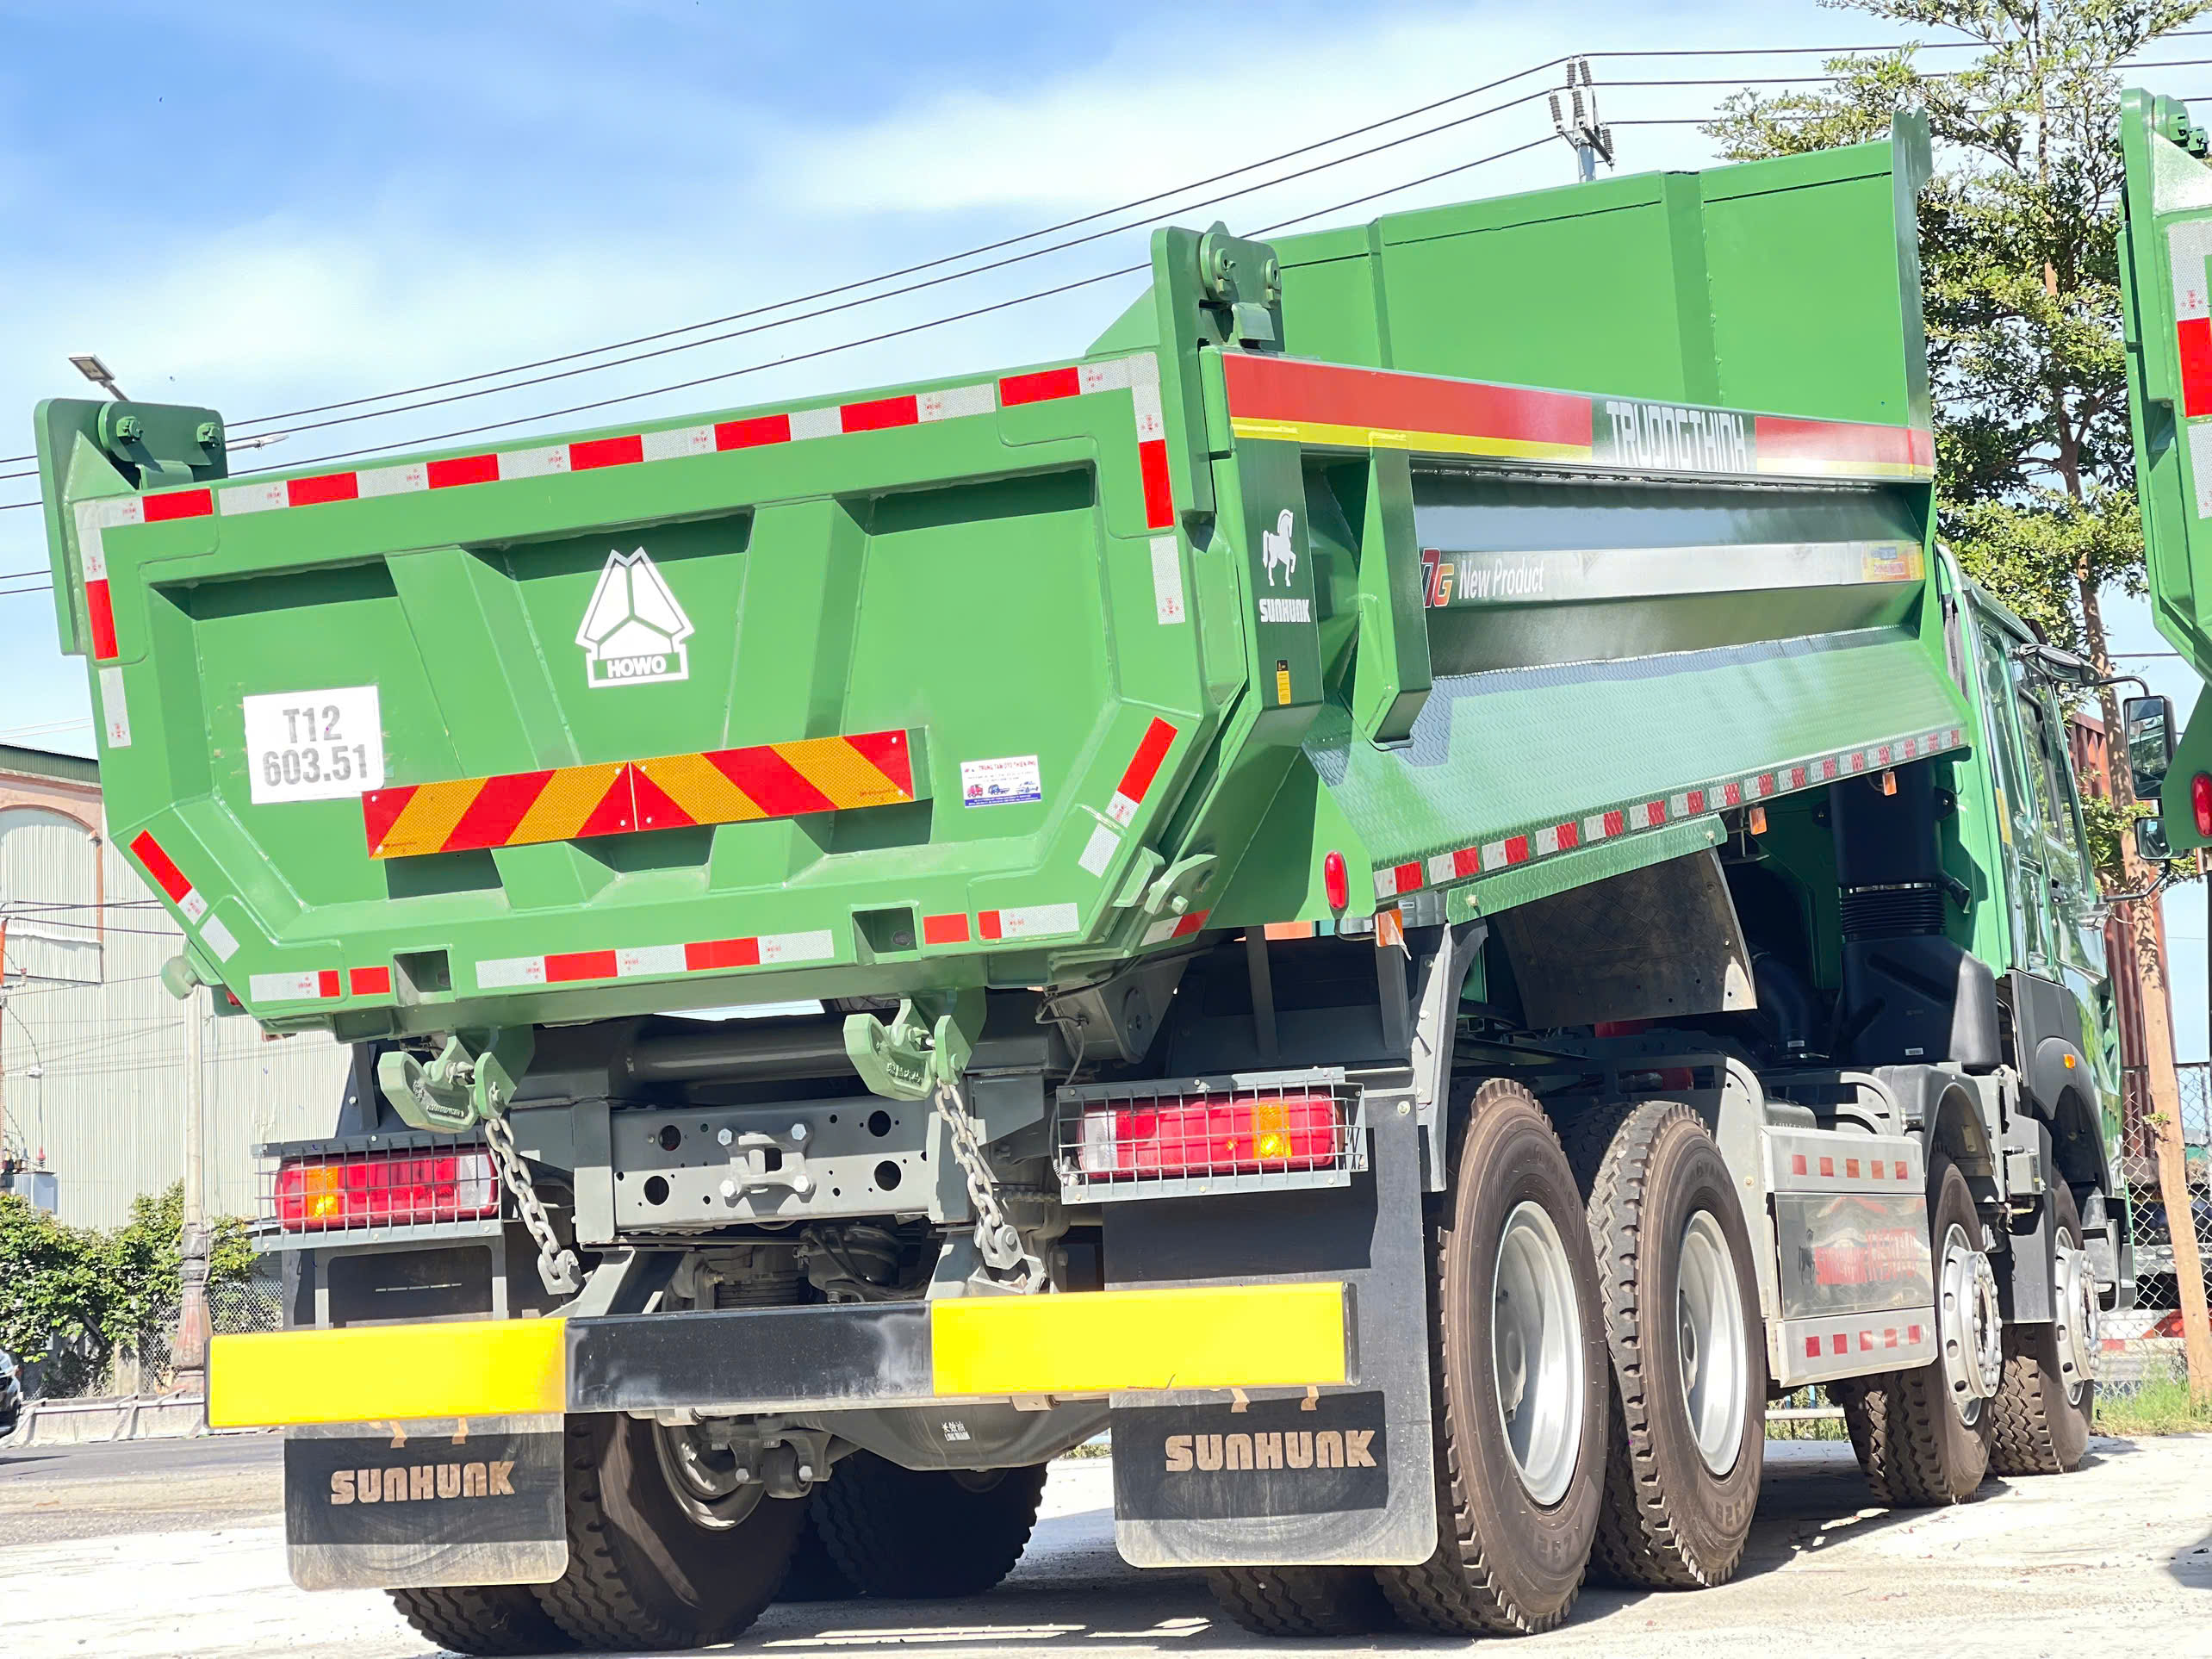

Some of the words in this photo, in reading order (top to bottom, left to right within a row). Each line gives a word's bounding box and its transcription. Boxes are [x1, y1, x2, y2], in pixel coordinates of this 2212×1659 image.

[1458, 560, 1491, 600] New
[1493, 556, 1544, 597] Product
[606, 655, 667, 679] HOWO
[283, 705, 343, 744] T12
[263, 743, 368, 787] 603.51
[1165, 1430, 1377, 1472] SUNHUNK
[331, 1461, 516, 1505] SUNHUNK
